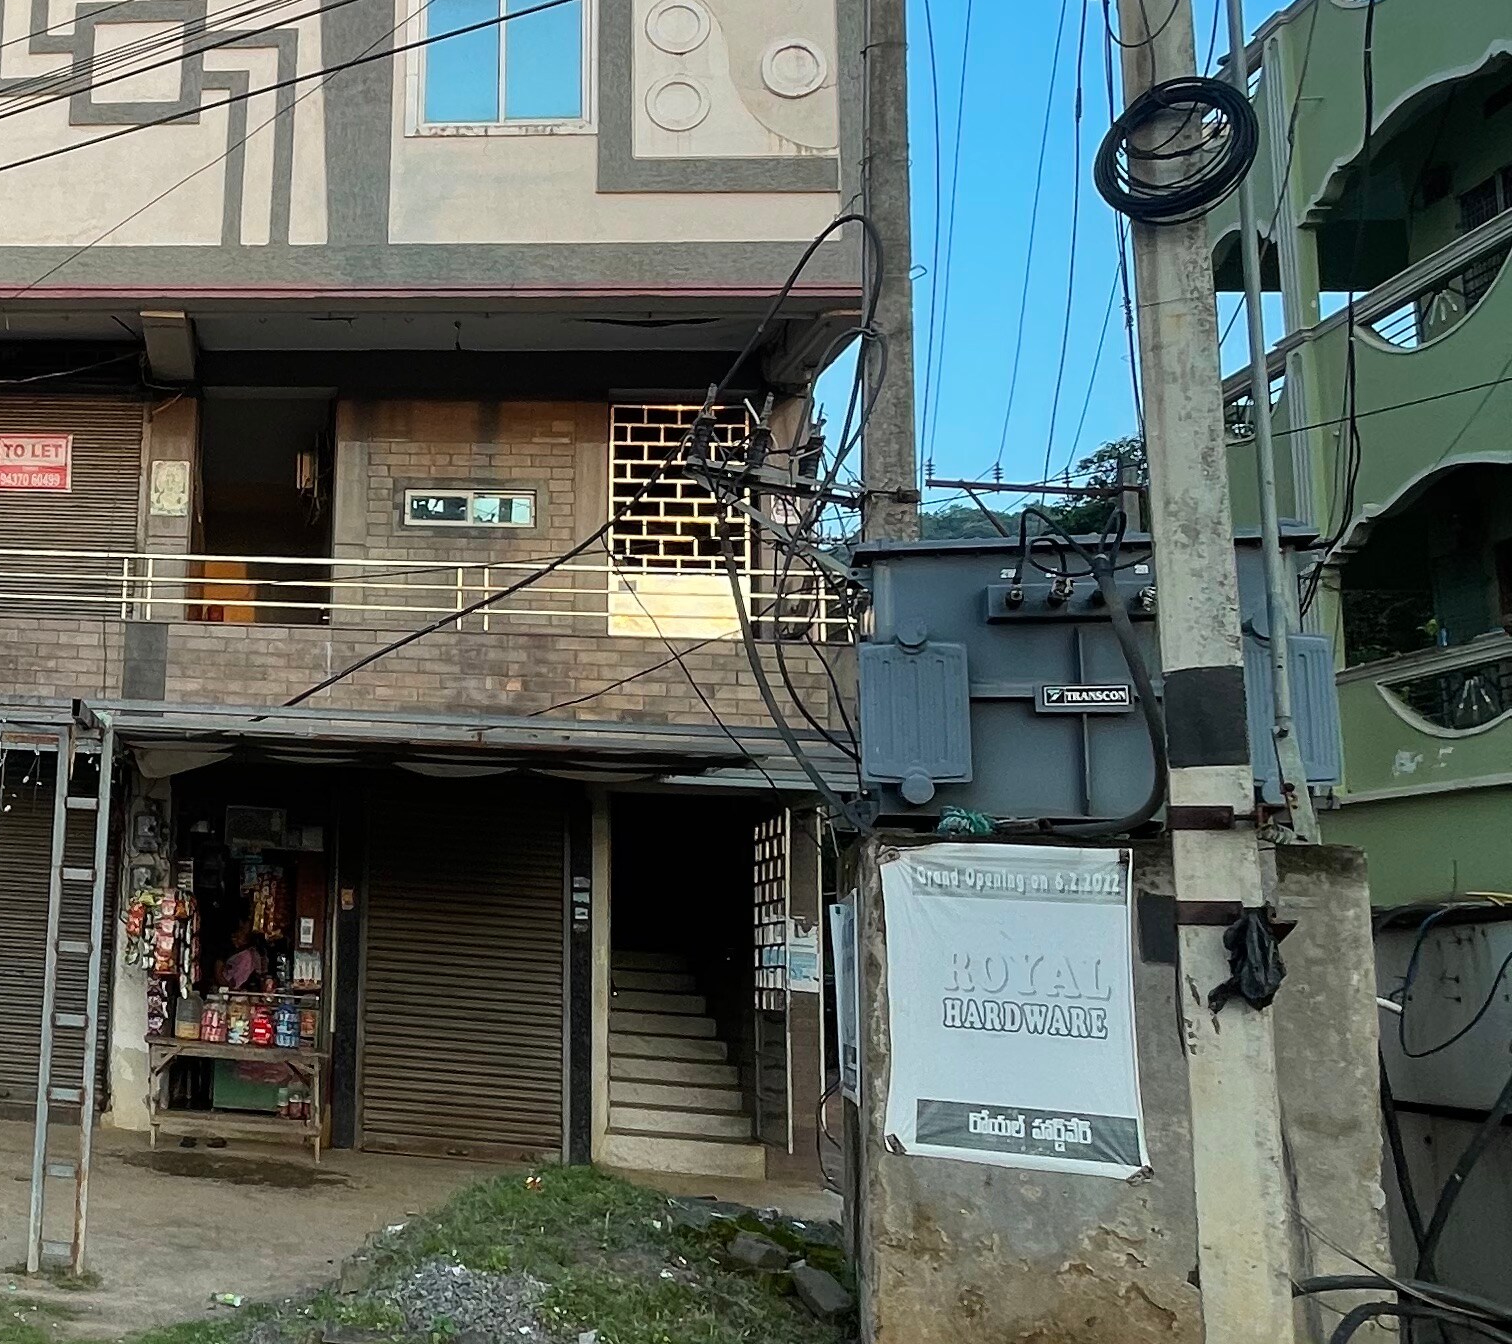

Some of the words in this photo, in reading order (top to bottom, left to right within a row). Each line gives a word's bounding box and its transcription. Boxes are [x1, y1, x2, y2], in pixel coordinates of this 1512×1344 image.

[3, 444, 25, 458] TO
[31, 444, 63, 458] LET
[1064, 690, 1127, 702] TRANSCON
[914, 866, 958, 886] Grand
[965, 867, 1025, 893] Opening
[1031, 873, 1049, 890] on
[1054, 872, 1121, 895] 6.2.2022
[944, 953, 1113, 1002] ROYAL
[943, 997, 1109, 1040] HARDWARE
